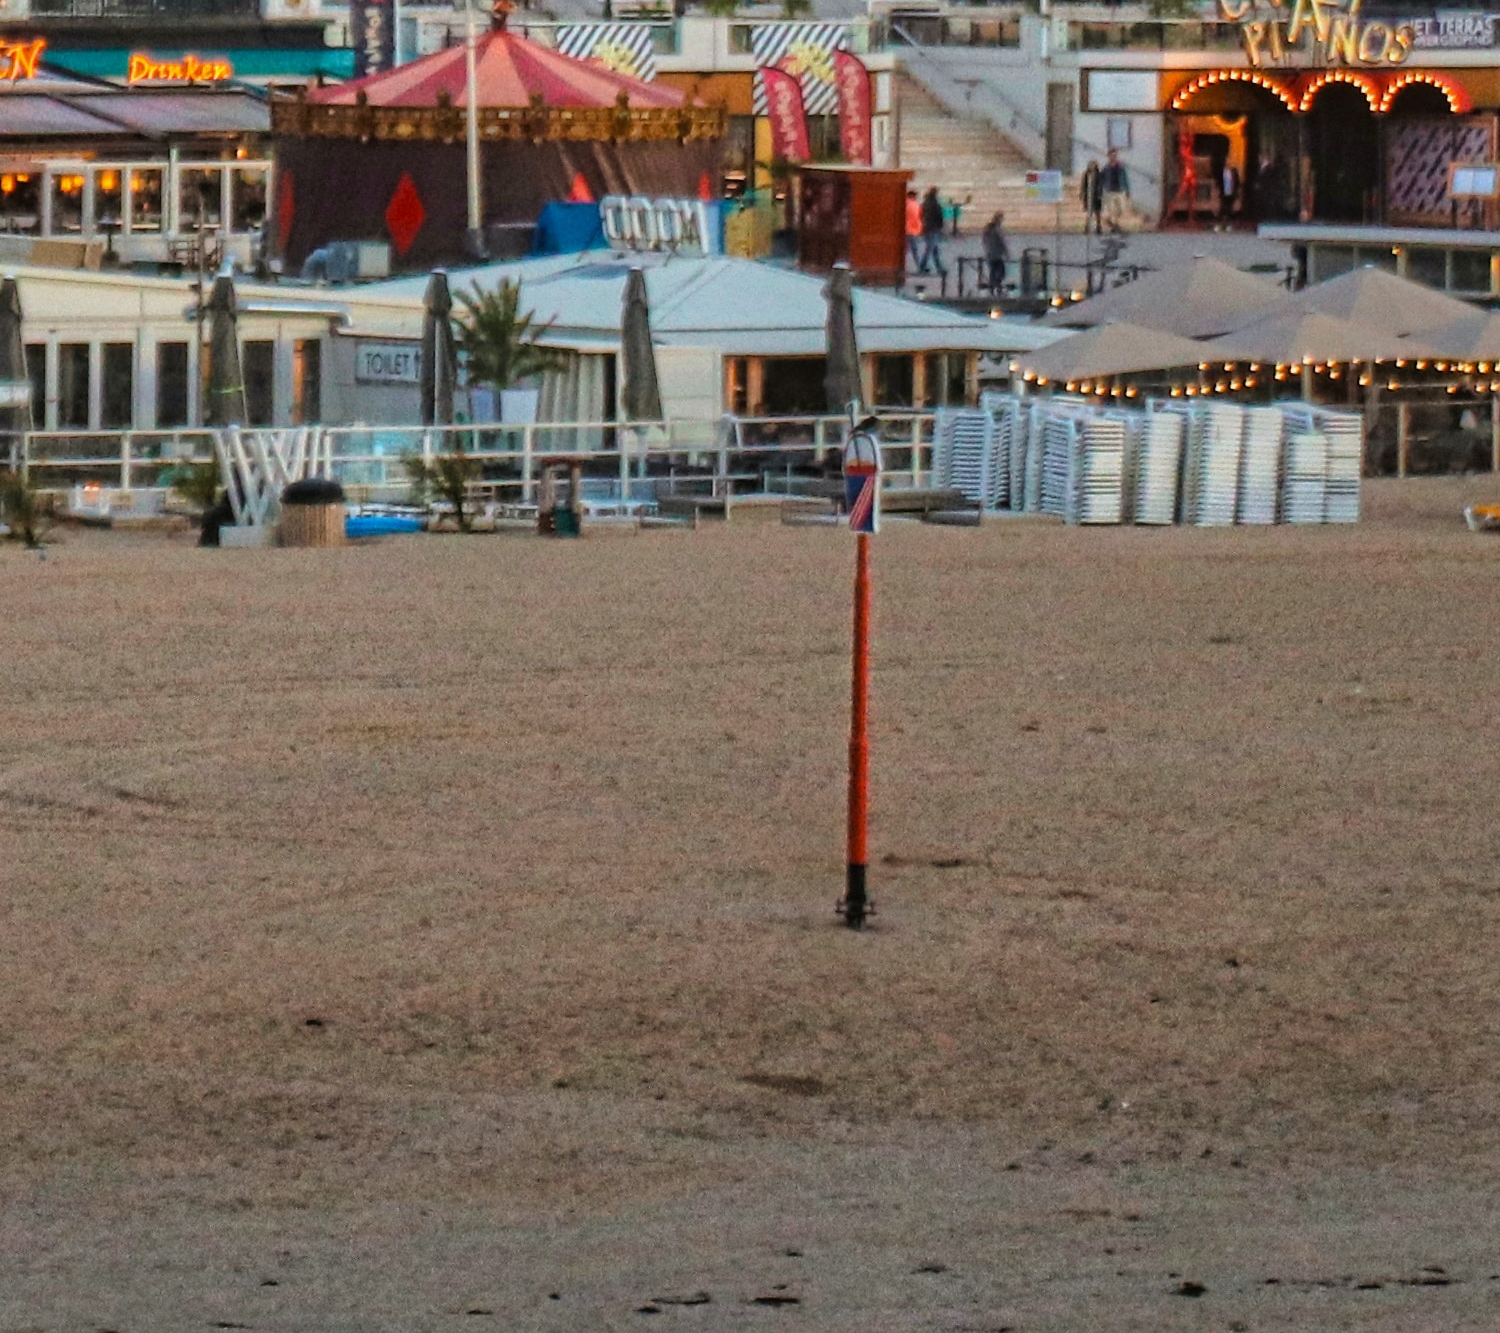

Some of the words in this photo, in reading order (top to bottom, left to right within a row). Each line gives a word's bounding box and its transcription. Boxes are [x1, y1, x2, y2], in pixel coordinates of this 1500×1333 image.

[1439, 16, 1492, 36] TERRAS
[128, 54, 231, 83] Drinken
[364, 352, 411, 375] TOILET
